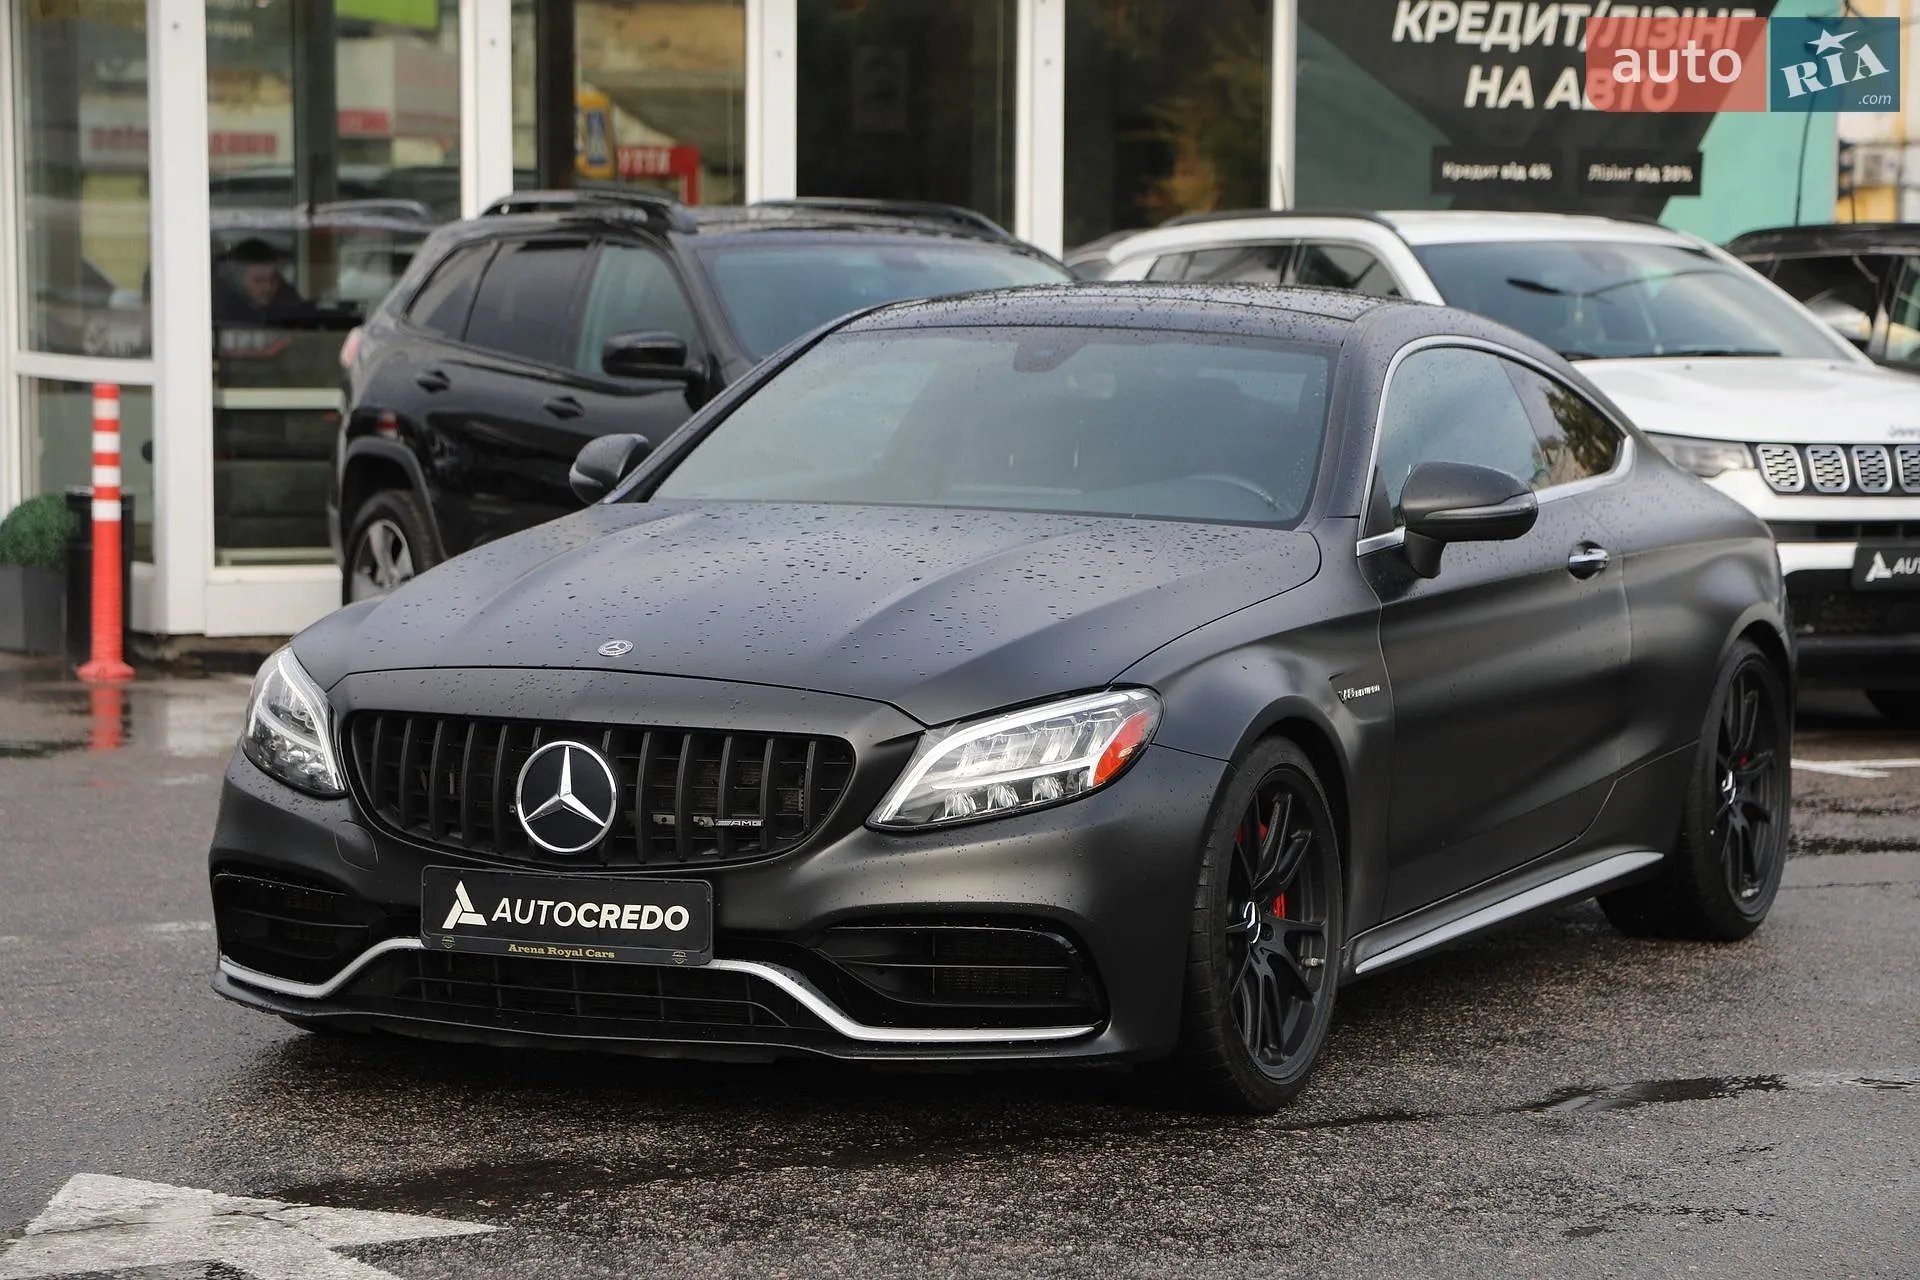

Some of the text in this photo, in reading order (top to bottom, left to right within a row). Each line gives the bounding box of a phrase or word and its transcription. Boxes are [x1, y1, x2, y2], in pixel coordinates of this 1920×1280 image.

[1391, 1, 1757, 52] КРЕДИТ/ЛІЗІНГ
[1463, 65, 1681, 113] НА АВТО
[491, 897, 690, 931] AUTOCREDO
[508, 943, 616, 959] Arena Royal Cars
